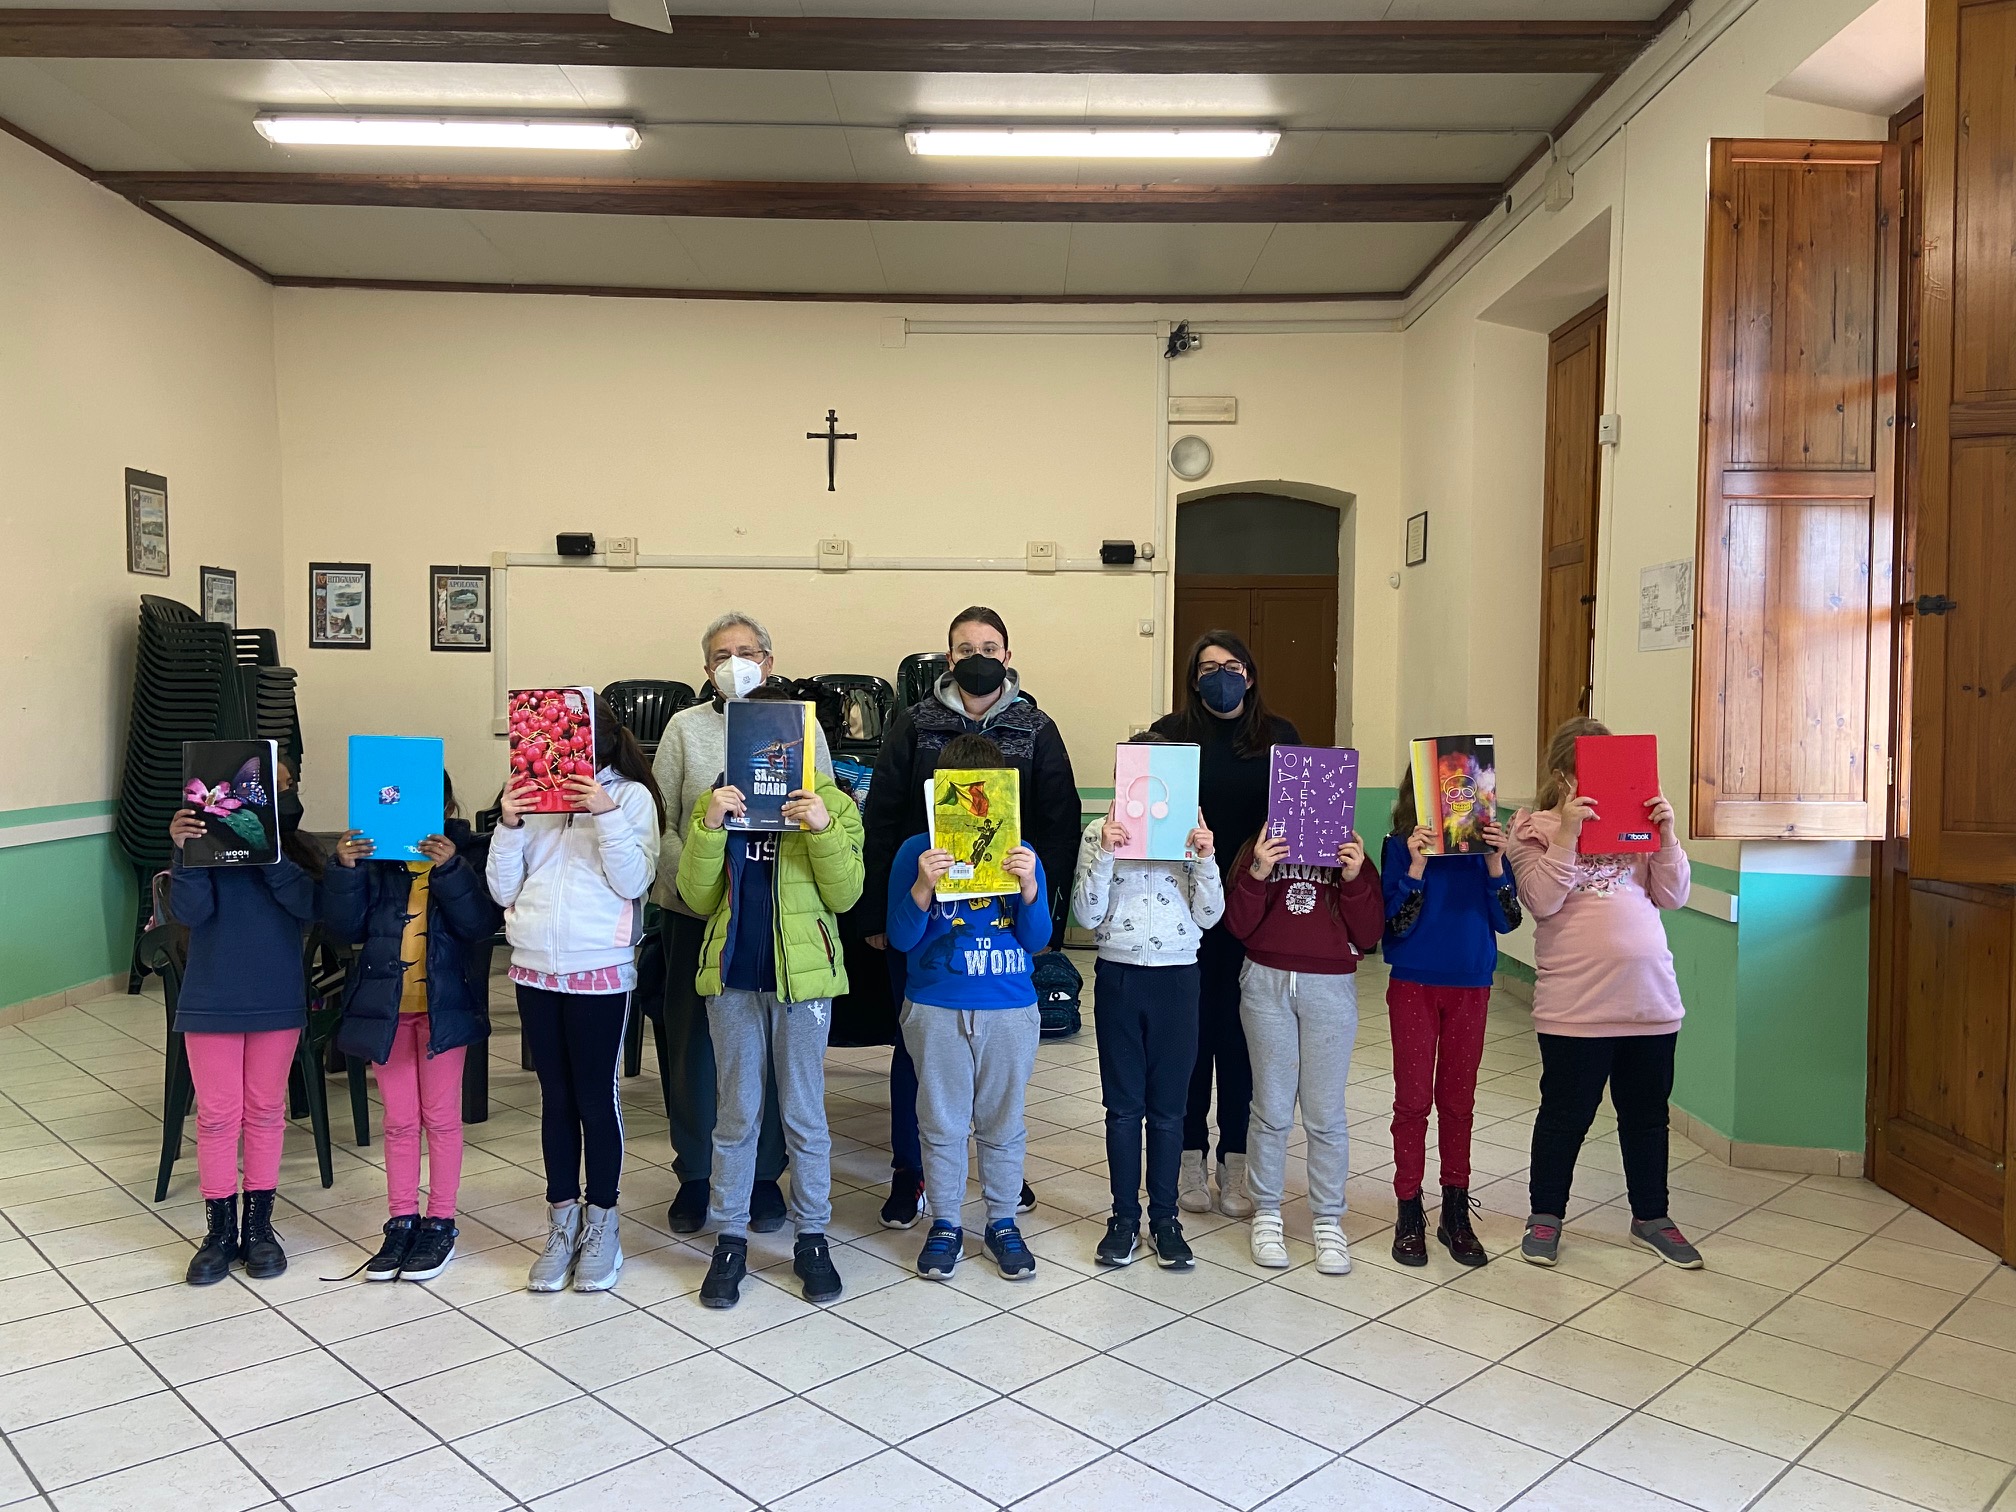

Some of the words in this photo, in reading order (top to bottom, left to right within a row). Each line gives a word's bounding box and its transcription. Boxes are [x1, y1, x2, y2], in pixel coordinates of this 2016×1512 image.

[753, 782, 788, 796] BOARD
[975, 937, 992, 950] TO
[964, 947, 1027, 977] WORK
